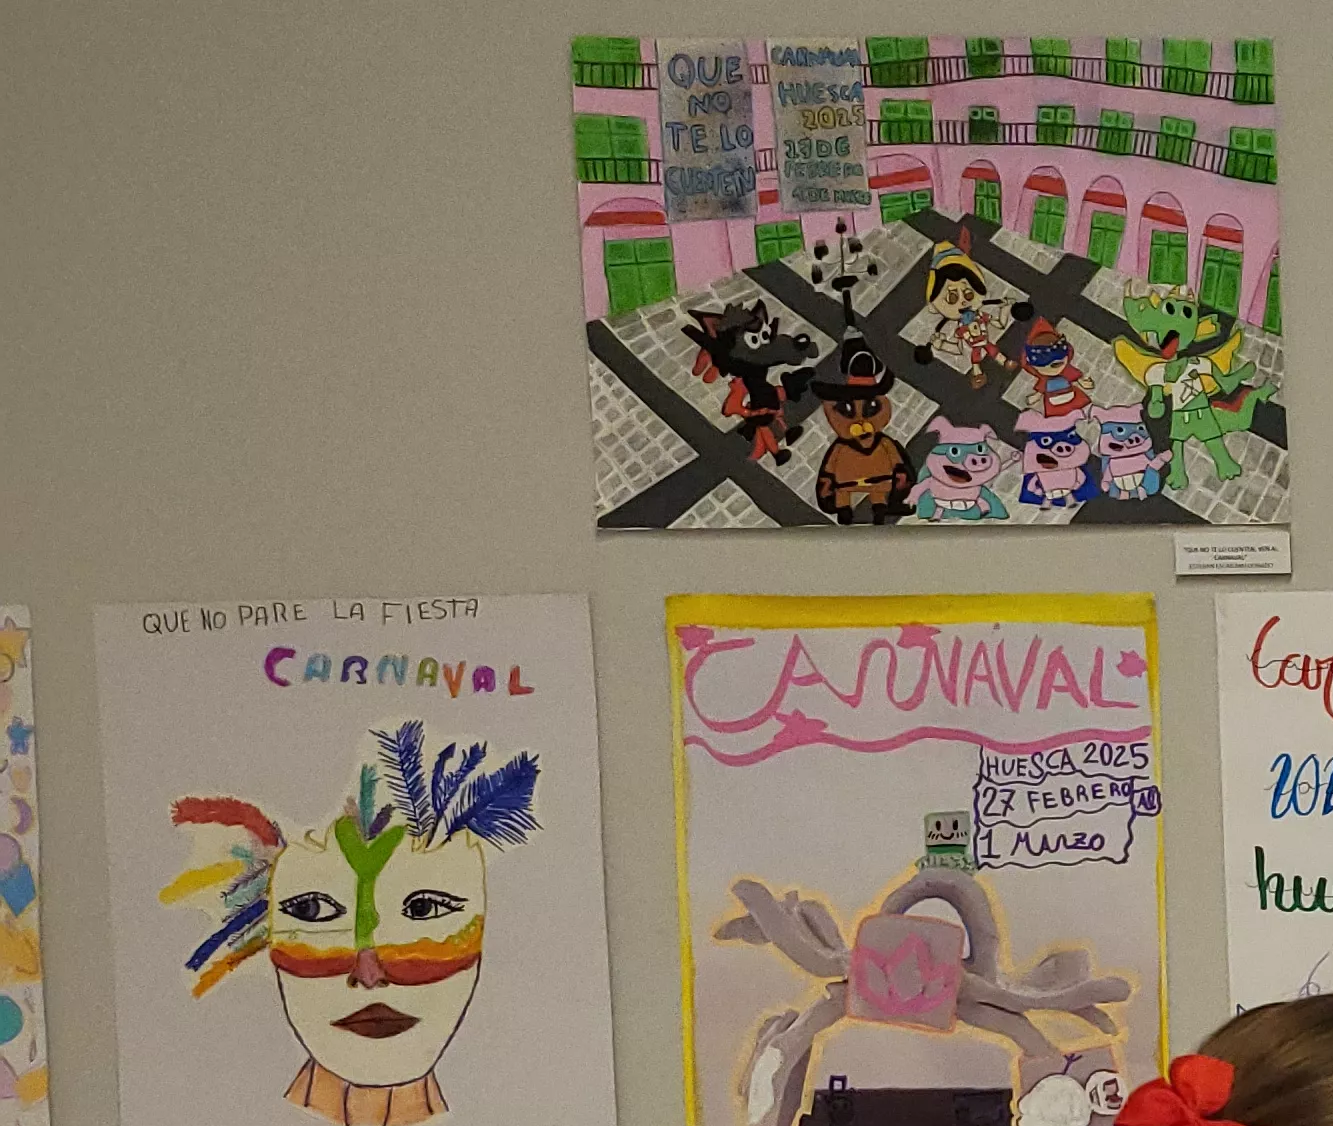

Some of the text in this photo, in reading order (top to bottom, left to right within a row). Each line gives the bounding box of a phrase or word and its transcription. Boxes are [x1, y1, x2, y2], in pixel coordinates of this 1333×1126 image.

[667, 53, 743, 90] QUE
[688, 90, 732, 117] NO
[778, 80, 865, 107] HUESCA
[801, 104, 867, 131] 2025
[665, 121, 754, 154] TE LO
[143, 598, 479, 635] QUE NO PARE LA FIESTA
[264, 646, 536, 699] CARNAVAL
[986, 742, 1150, 780] HUESCA 2025
[982, 786, 1016, 817] 27
[1027, 783, 1132, 813] FEBRERO
[980, 829, 1105, 859] 1 MARZO
